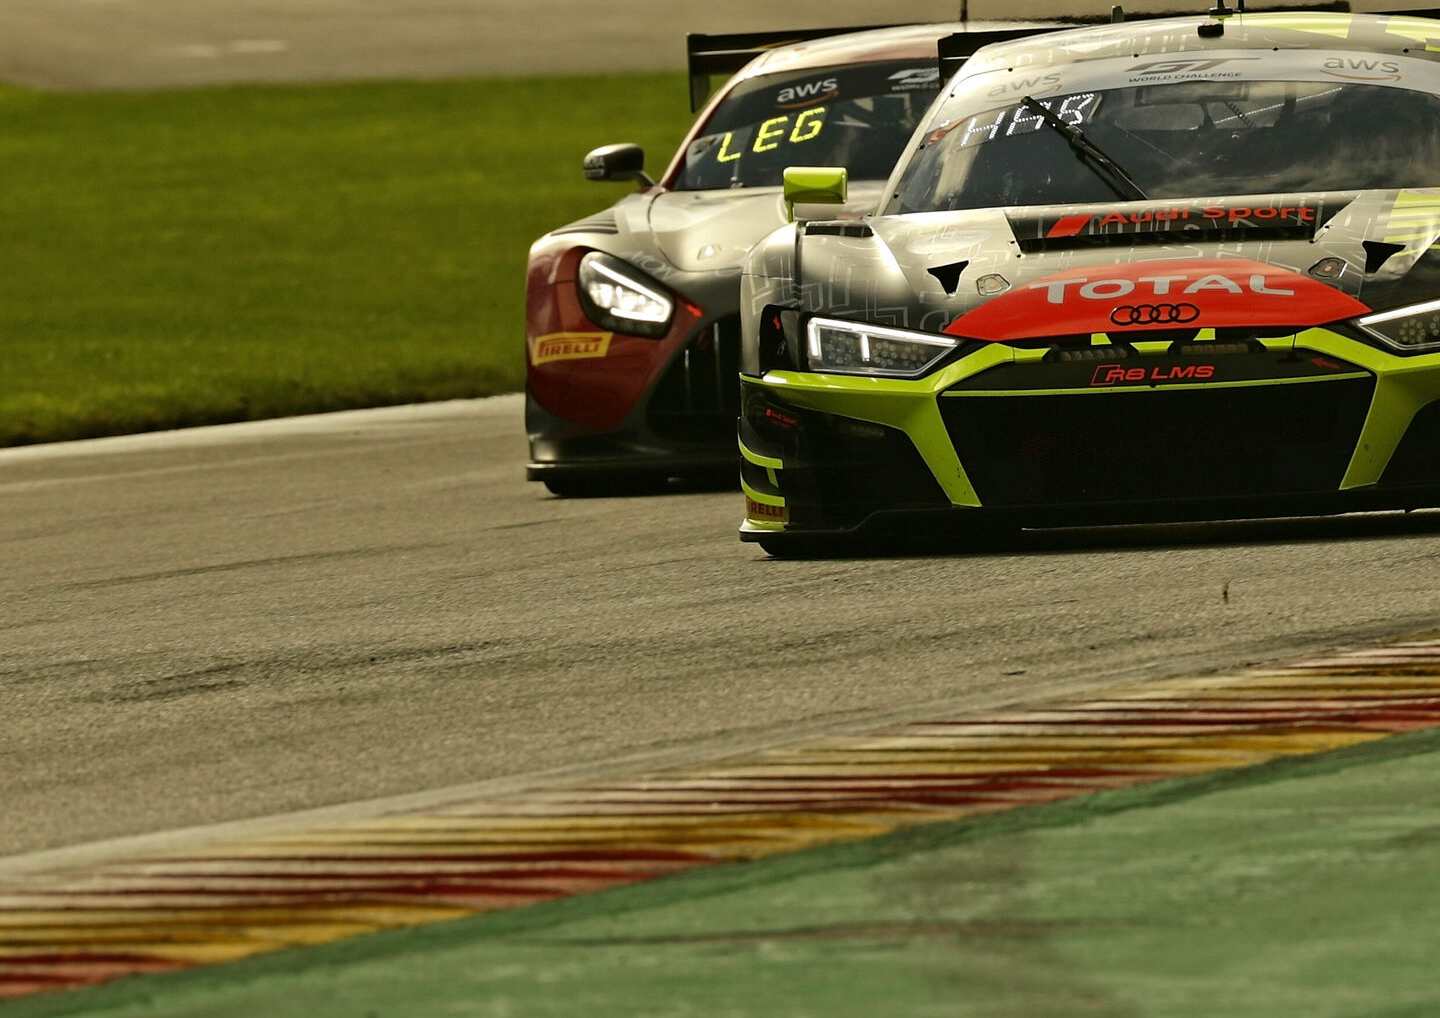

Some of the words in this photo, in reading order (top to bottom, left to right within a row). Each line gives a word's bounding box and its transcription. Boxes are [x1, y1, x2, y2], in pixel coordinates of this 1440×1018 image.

[1125, 57, 1263, 76] GT
[1128, 73, 1173, 83] WORLD
[1175, 71, 1242, 80] CHALLENGE
[1323, 57, 1400, 74] aws
[776, 77, 839, 103] aws
[988, 72, 1061, 98] aws
[716, 106, 826, 163] LEG
[1099, 206, 1190, 227] Audi
[1202, 204, 1316, 222] Sport
[1029, 274, 1295, 304] TOTAL
[538, 335, 602, 358] PIRELLI
[1100, 366, 1146, 383] R8
[1151, 365, 1215, 380] LMS
